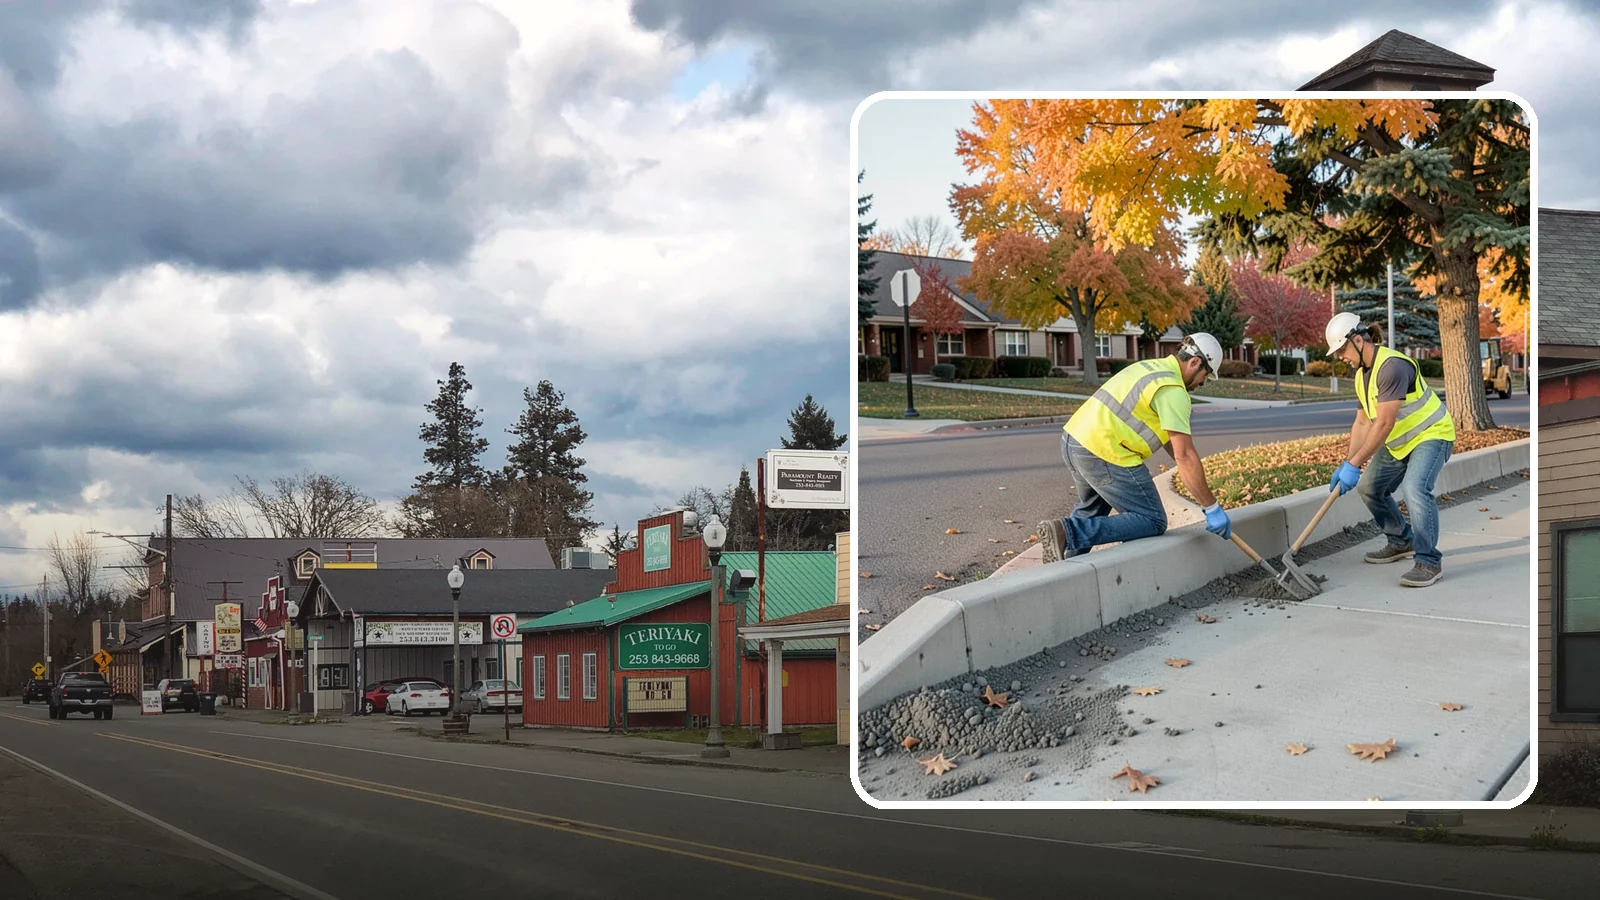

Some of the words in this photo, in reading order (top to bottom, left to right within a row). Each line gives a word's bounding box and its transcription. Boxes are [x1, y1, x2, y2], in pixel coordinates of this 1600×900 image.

[625, 627, 702, 646] TERIYAKI
[629, 654, 649, 664] 253
[651, 653, 700, 664] 843-9668
